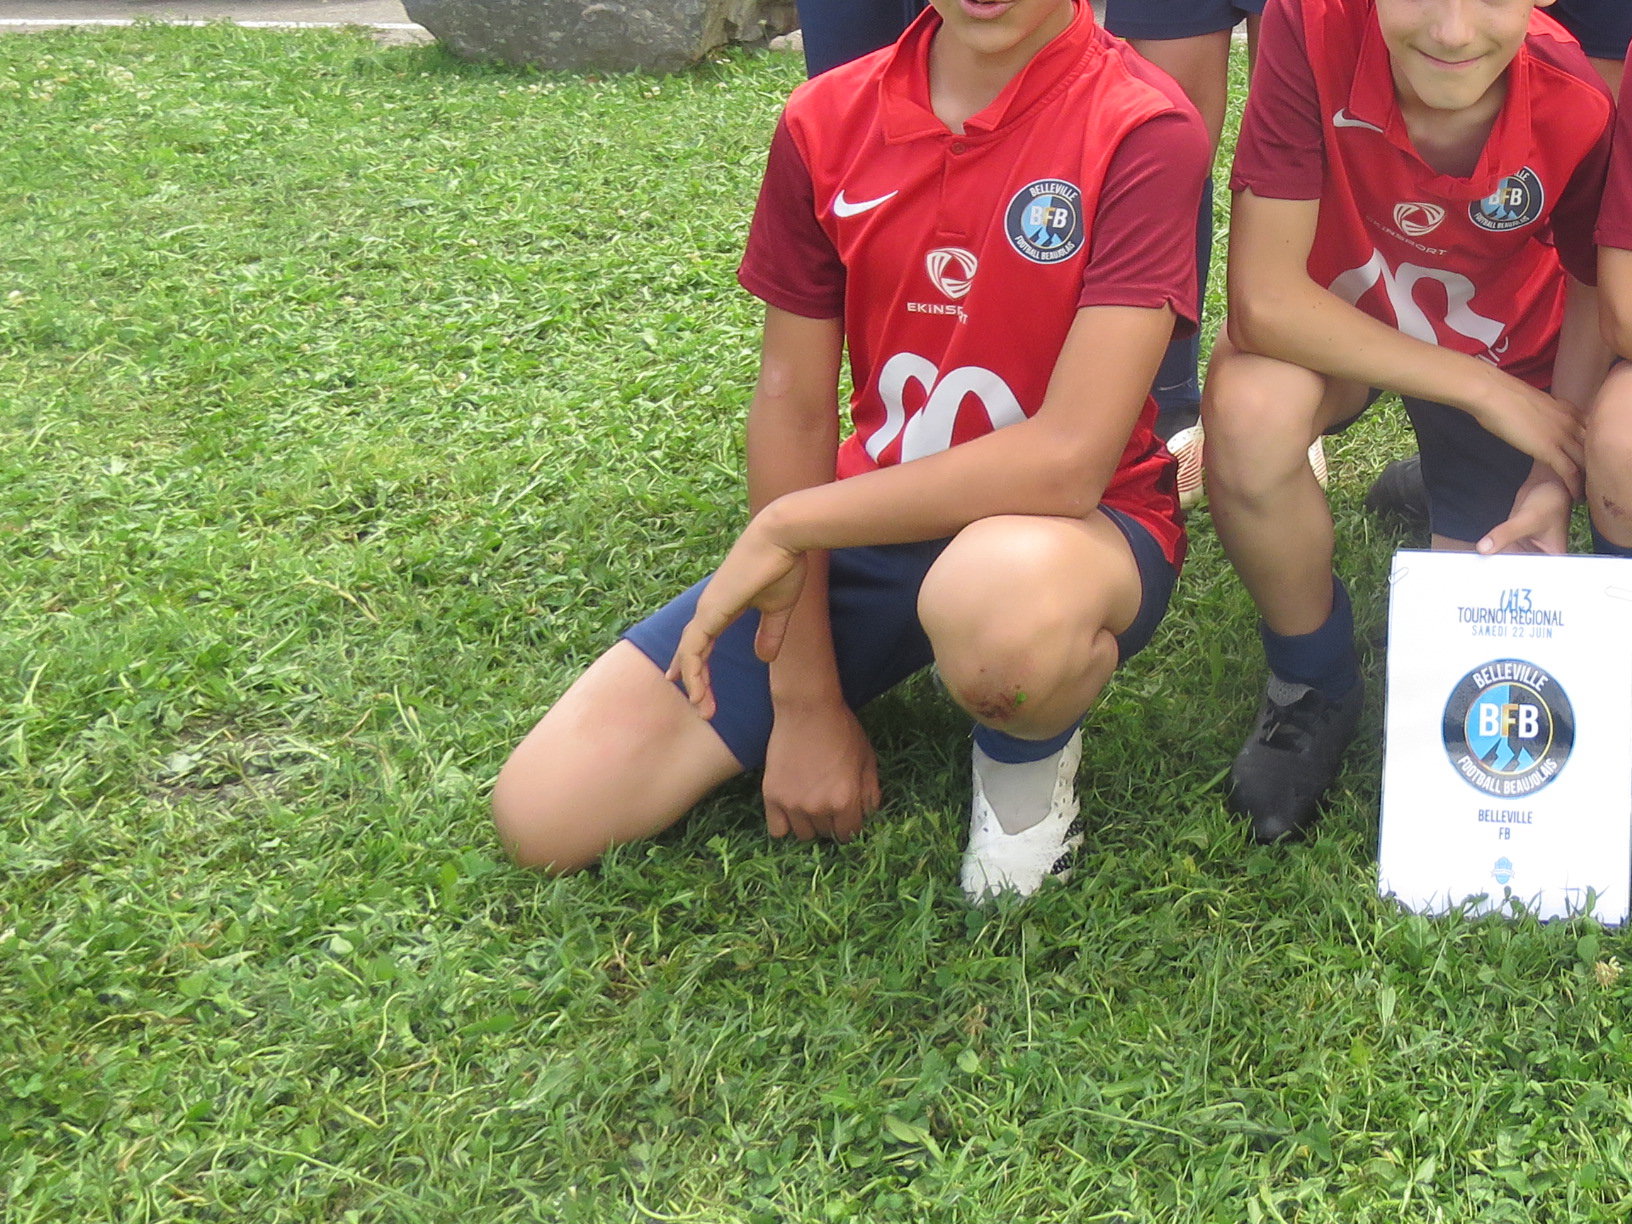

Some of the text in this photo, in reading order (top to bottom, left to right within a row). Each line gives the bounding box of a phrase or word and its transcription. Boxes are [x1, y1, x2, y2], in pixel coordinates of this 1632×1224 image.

[1029, 183, 1078, 201] BELLEVILLE
[1030, 206, 1068, 228] BFB
[1015, 235, 1040, 259] FOOTBALL
[1500, 588, 1532, 614] U13
[1458, 607, 1507, 624] TOURNOI
[1472, 625, 1552, 638] SAMEDI 22 JUIN
[1472, 663, 1549, 691] BELLEVILLE
[1479, 703, 1539, 738] BFB
[1458, 755, 1558, 794] FOOTBALL BEAUJOLAIS
[1478, 809, 1533, 824] BELLEVILLE
[1498, 827, 1511, 840] FB
